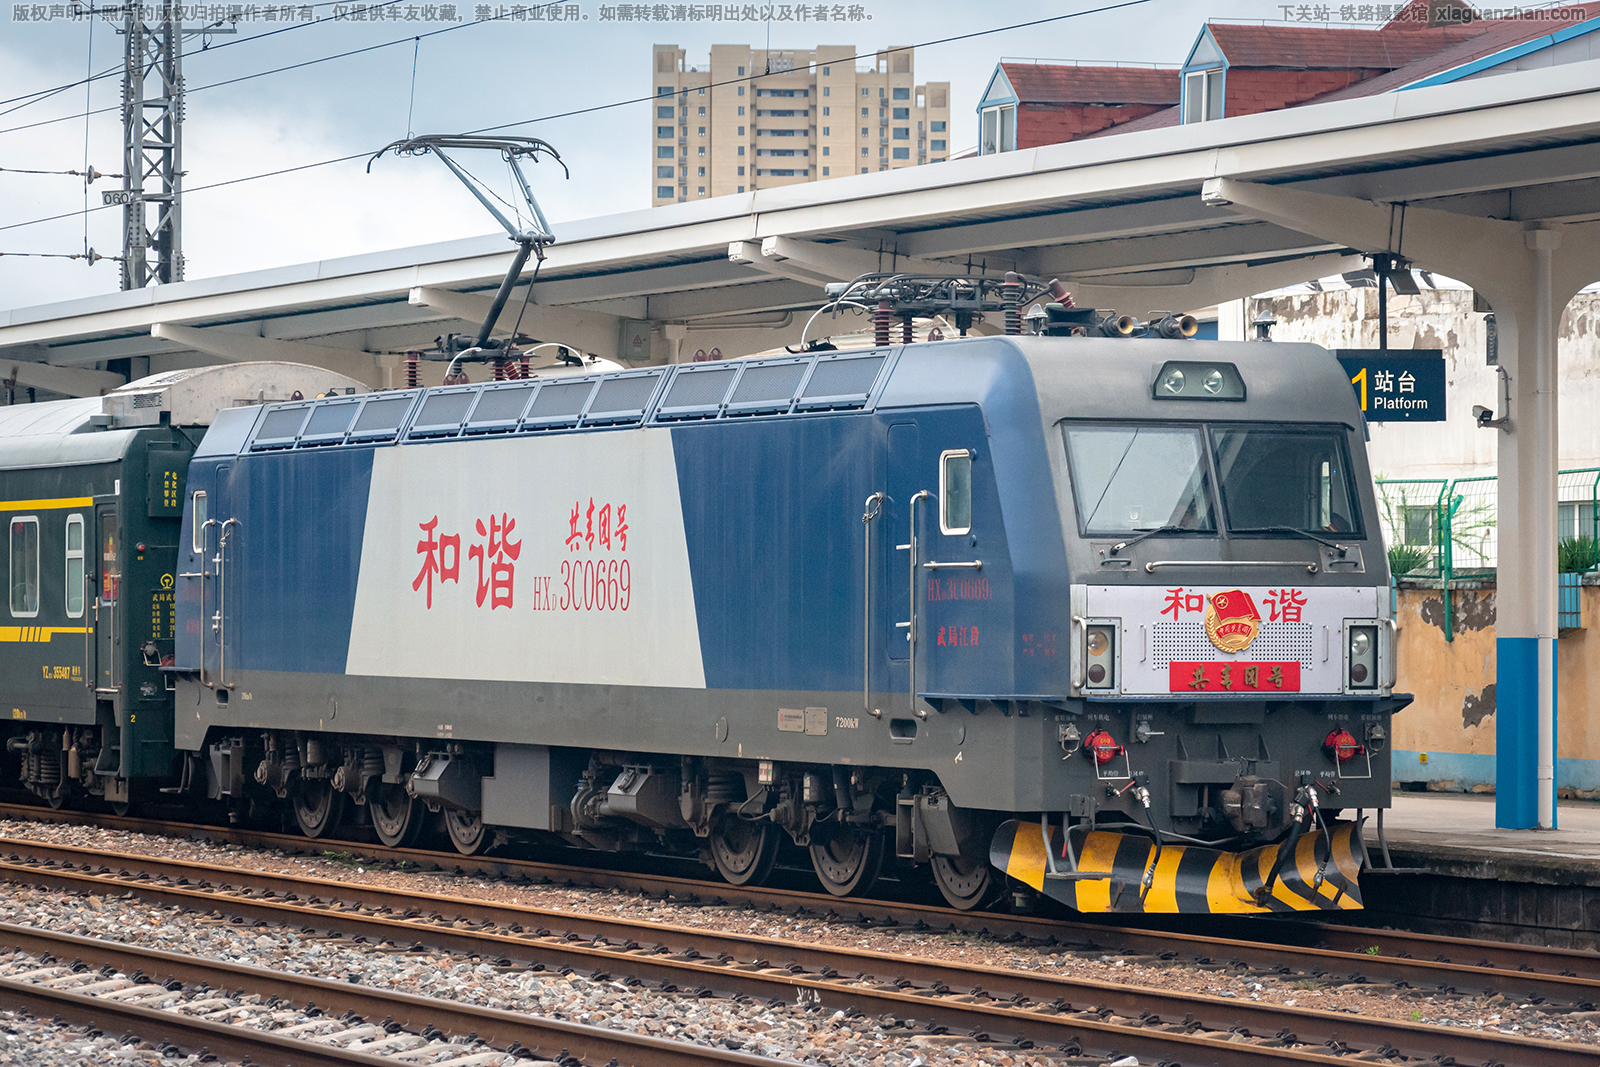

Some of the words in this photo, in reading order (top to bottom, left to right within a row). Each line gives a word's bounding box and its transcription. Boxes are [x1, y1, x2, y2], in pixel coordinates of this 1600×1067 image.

[104, 193, 129, 205] 060
[1351, 368, 1367, 411] 1
[1374, 370, 1416, 393] 站台
[1374, 397, 1428, 409] Platform
[565, 496, 629, 552] 共青团号
[412, 512, 522, 610] 和谐
[1188, 664, 1284, 690] 共青团号
[130, 715, 136, 723] 2
[835, 716, 859, 728] 7200kW
